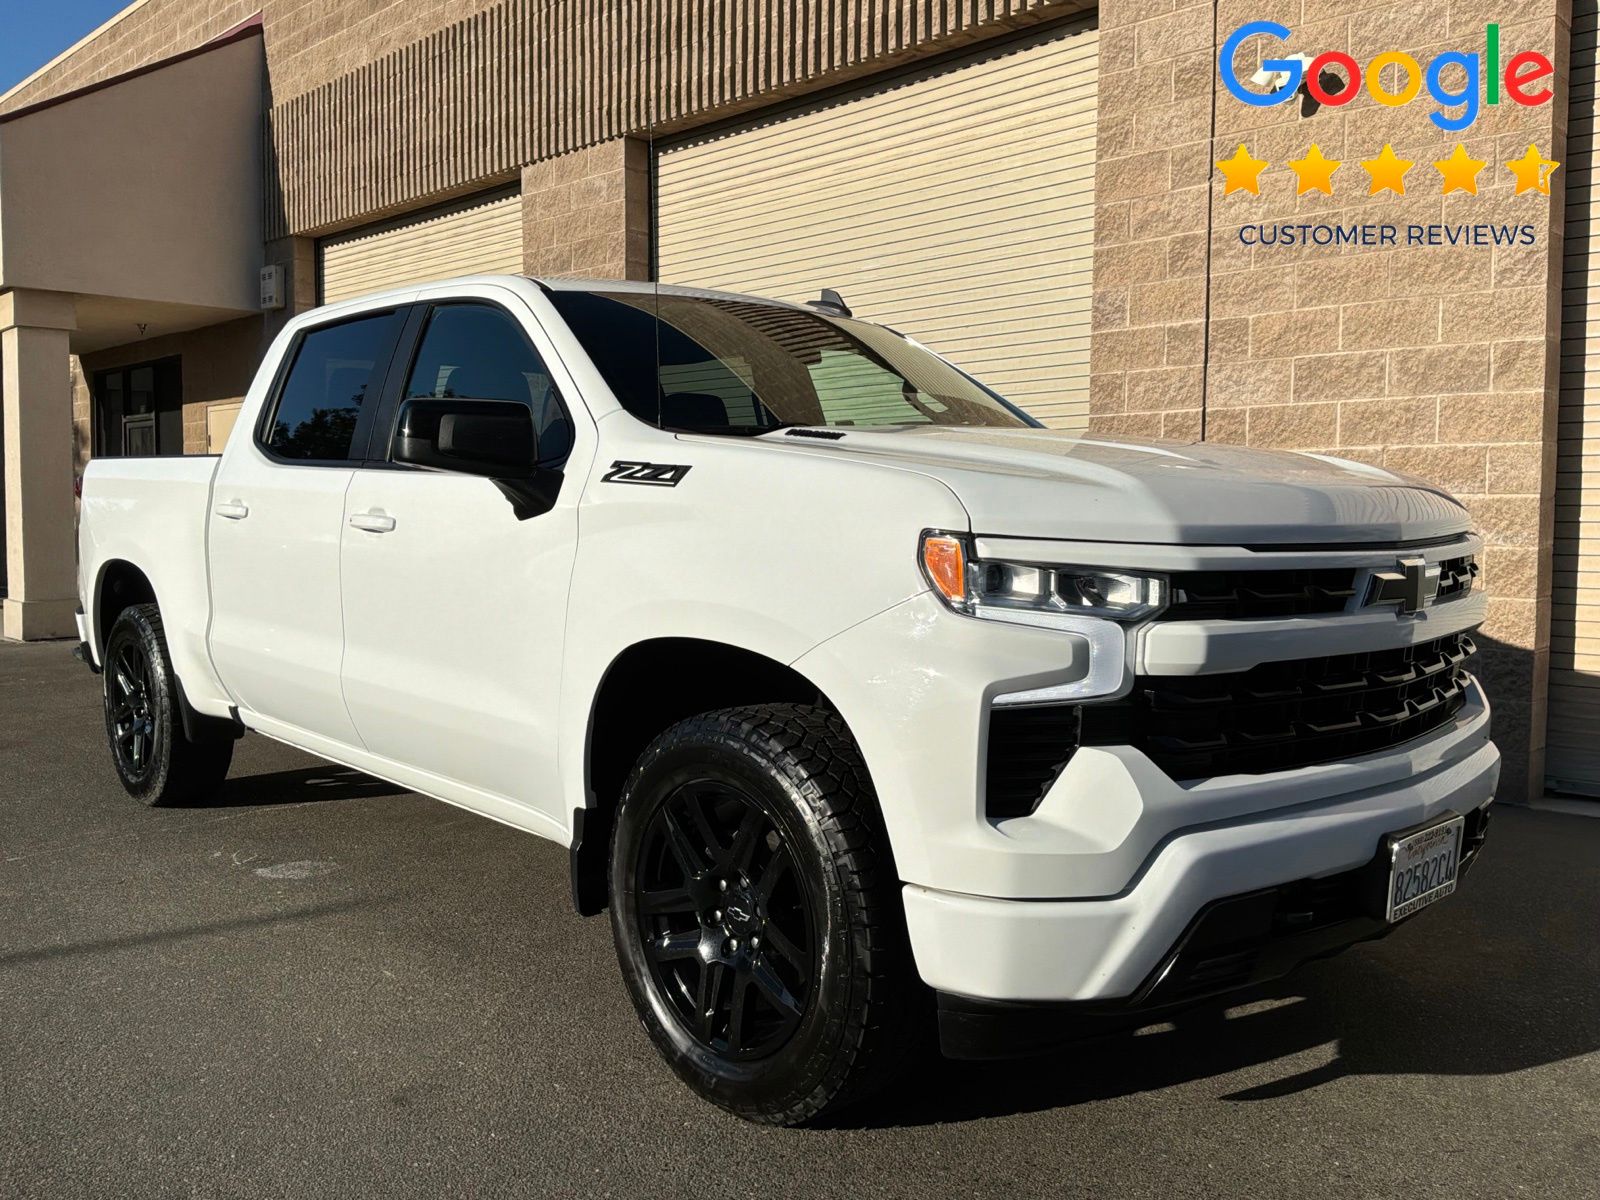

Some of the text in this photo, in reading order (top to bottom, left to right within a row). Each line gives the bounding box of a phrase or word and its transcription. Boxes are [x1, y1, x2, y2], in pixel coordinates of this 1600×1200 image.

[600, 460, 693, 488] Z71
[1393, 883, 1454, 919] EXECUTIVE AUTO
